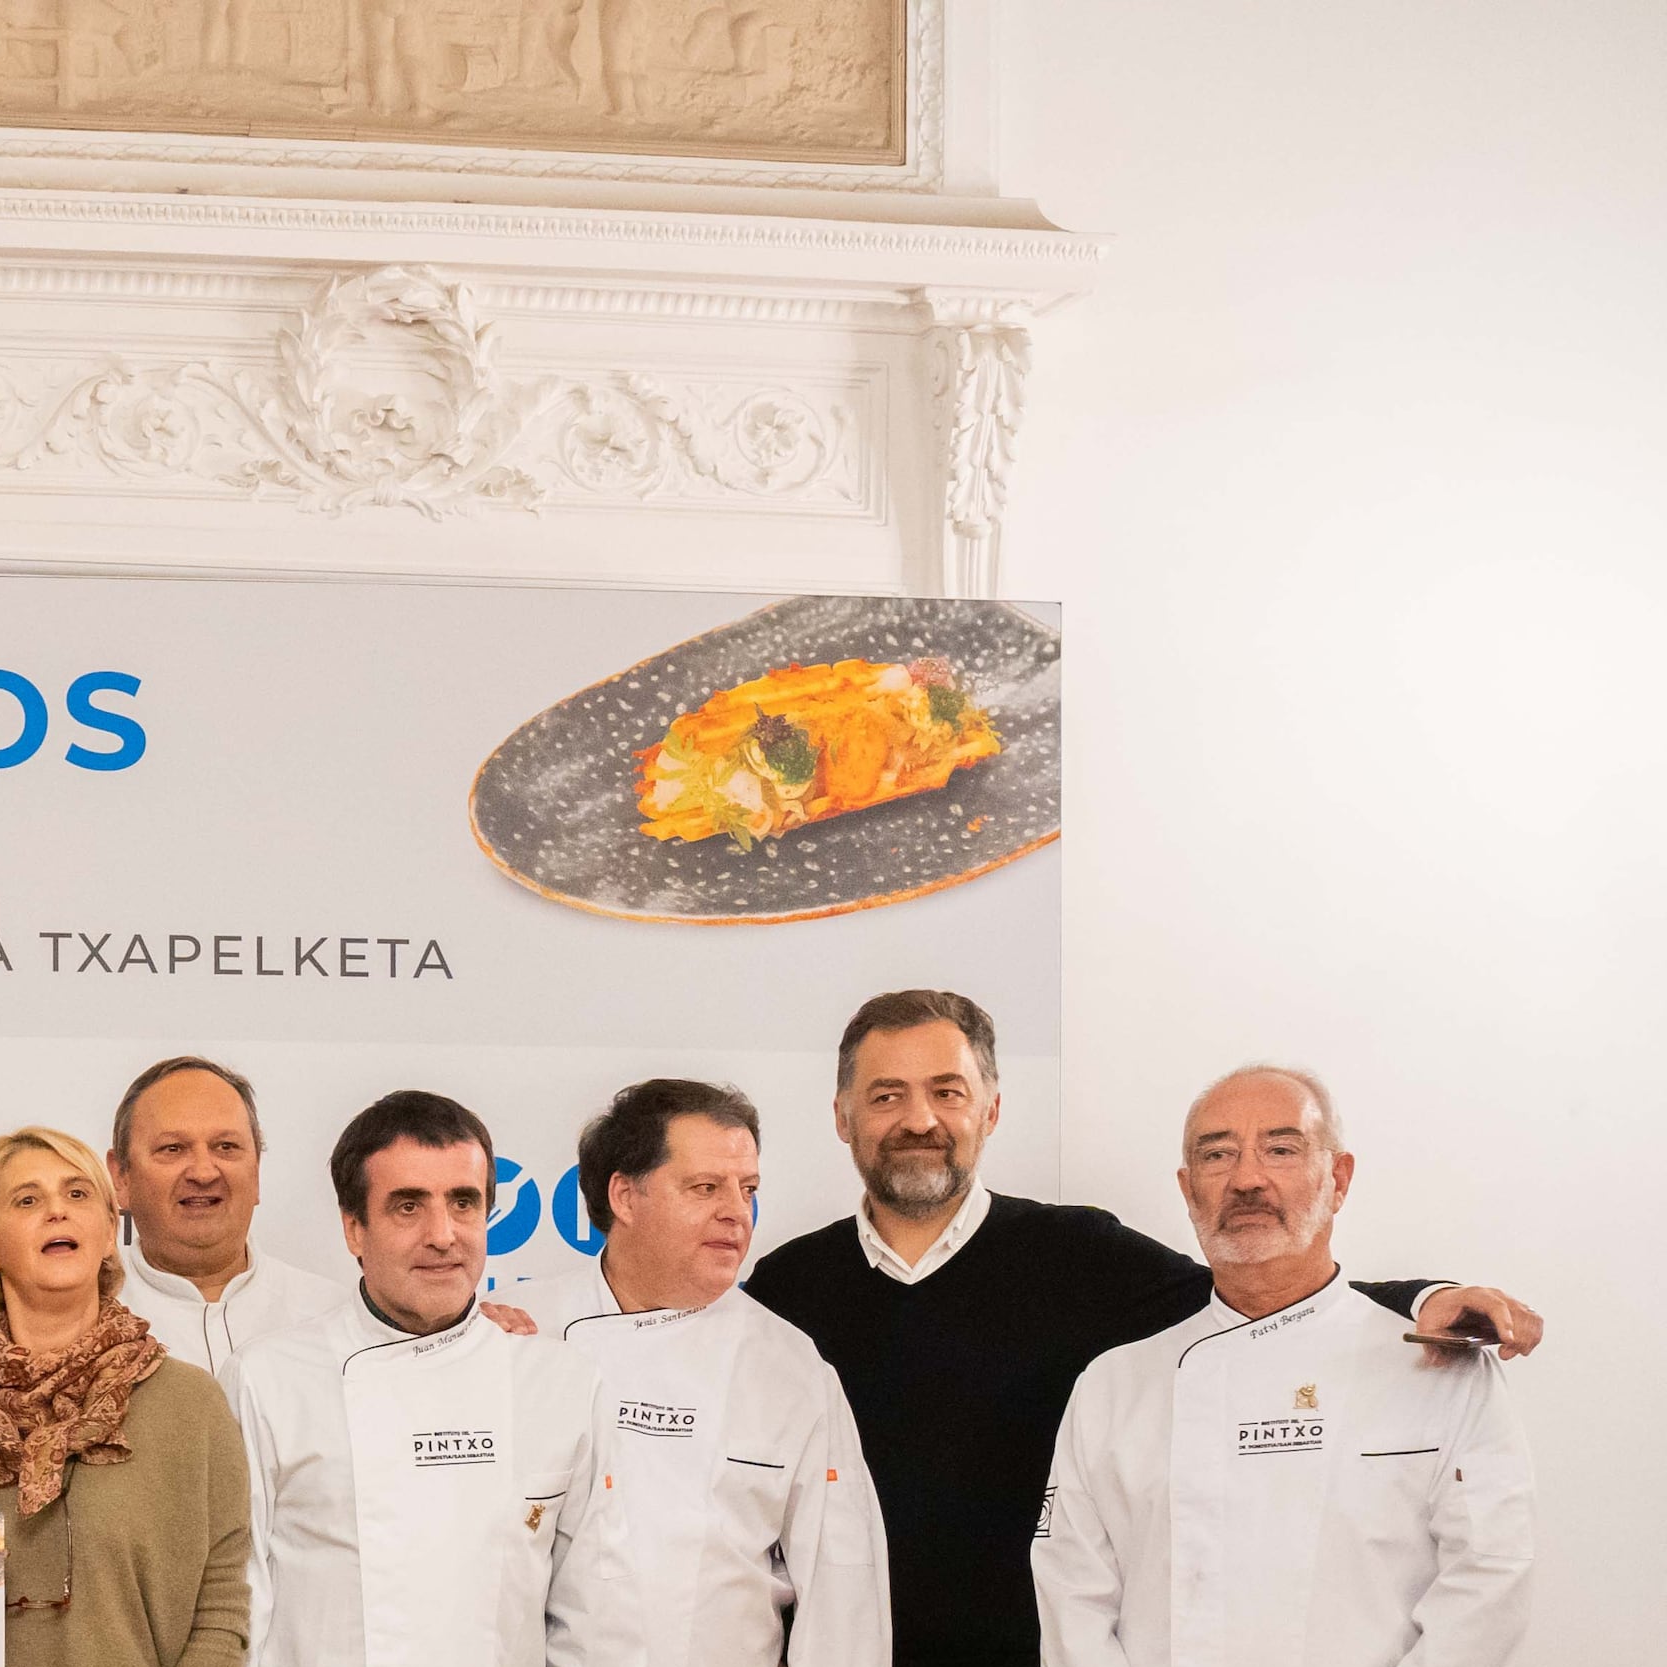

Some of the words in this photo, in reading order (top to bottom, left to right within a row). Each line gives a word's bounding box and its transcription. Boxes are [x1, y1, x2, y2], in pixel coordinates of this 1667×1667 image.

[39, 932, 453, 979] TXAPELKETA
[619, 1407, 695, 1425] PINTXO
[1239, 1425, 1323, 1442] PINTXO
[414, 1438, 494, 1453] PINTXO
